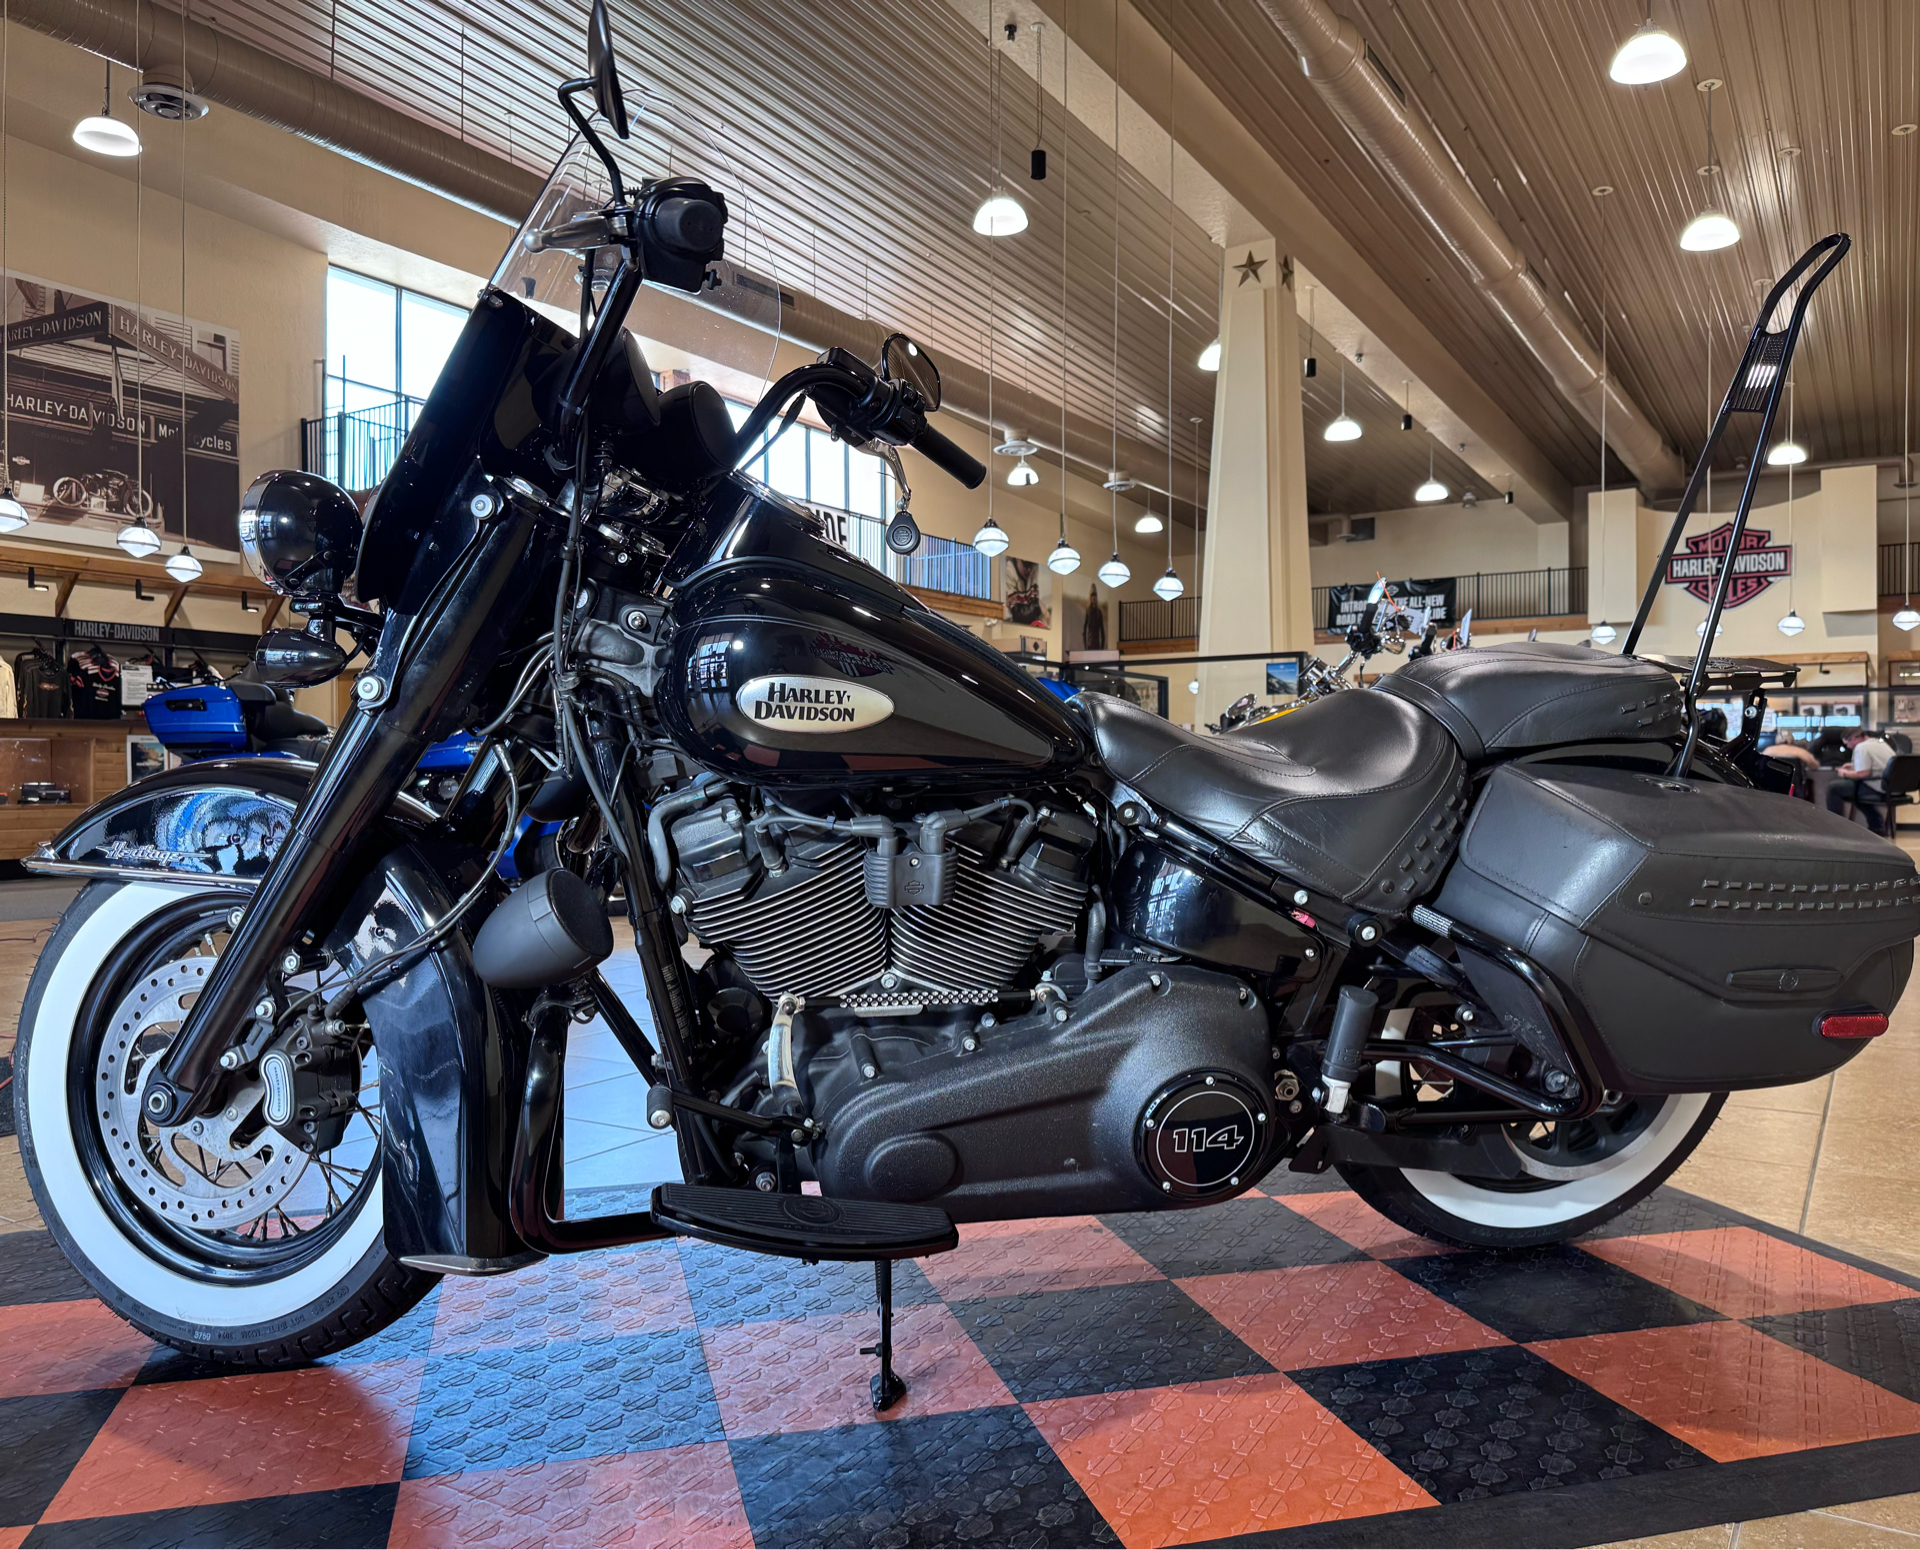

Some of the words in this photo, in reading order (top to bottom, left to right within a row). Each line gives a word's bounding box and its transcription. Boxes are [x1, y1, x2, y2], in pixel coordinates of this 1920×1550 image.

[2, 311, 102, 342] ARLEY-DAVIDSON
[120, 316, 238, 394] HARLEY-DAVIDSON
[6, 394, 146, 434] HARLEY-DAVIDSON
[1672, 552, 1785, 578] HARLEY-AVIDSON
[1409, 594, 1445, 608] ALL-NEW
[1697, 577, 1759, 601] CYLES
[74, 620, 160, 643] HARLEY-DAVIDSON
[754, 700, 855, 722] DAVIDSON
[105, 840, 184, 867] Heritage
[1172, 1124, 1245, 1154] 114
